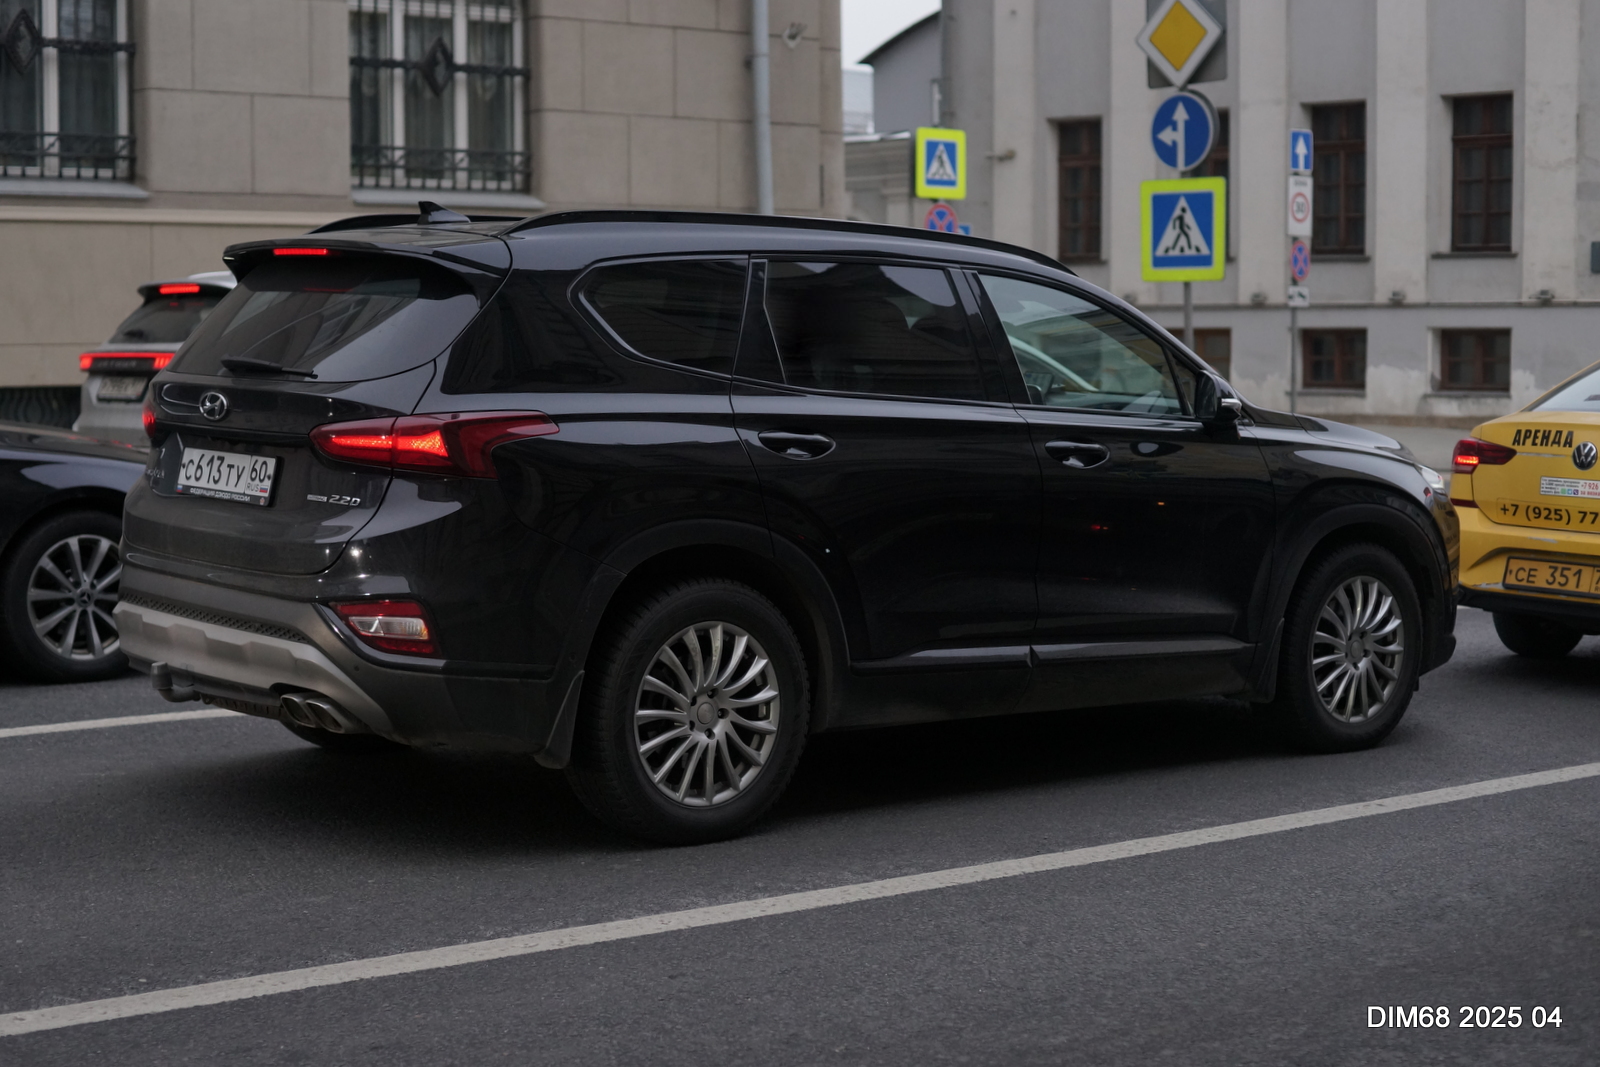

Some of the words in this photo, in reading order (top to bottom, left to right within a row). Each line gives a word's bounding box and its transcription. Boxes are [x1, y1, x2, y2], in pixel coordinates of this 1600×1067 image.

[1512, 429, 1574, 448] АРЕНДА
[249, 458, 269, 483] 60
[246, 482, 260, 492] RUS
[1500, 504, 1519, 516] +7
[1525, 505, 1571, 525] (925)
[1545, 565, 1583, 589] 351
